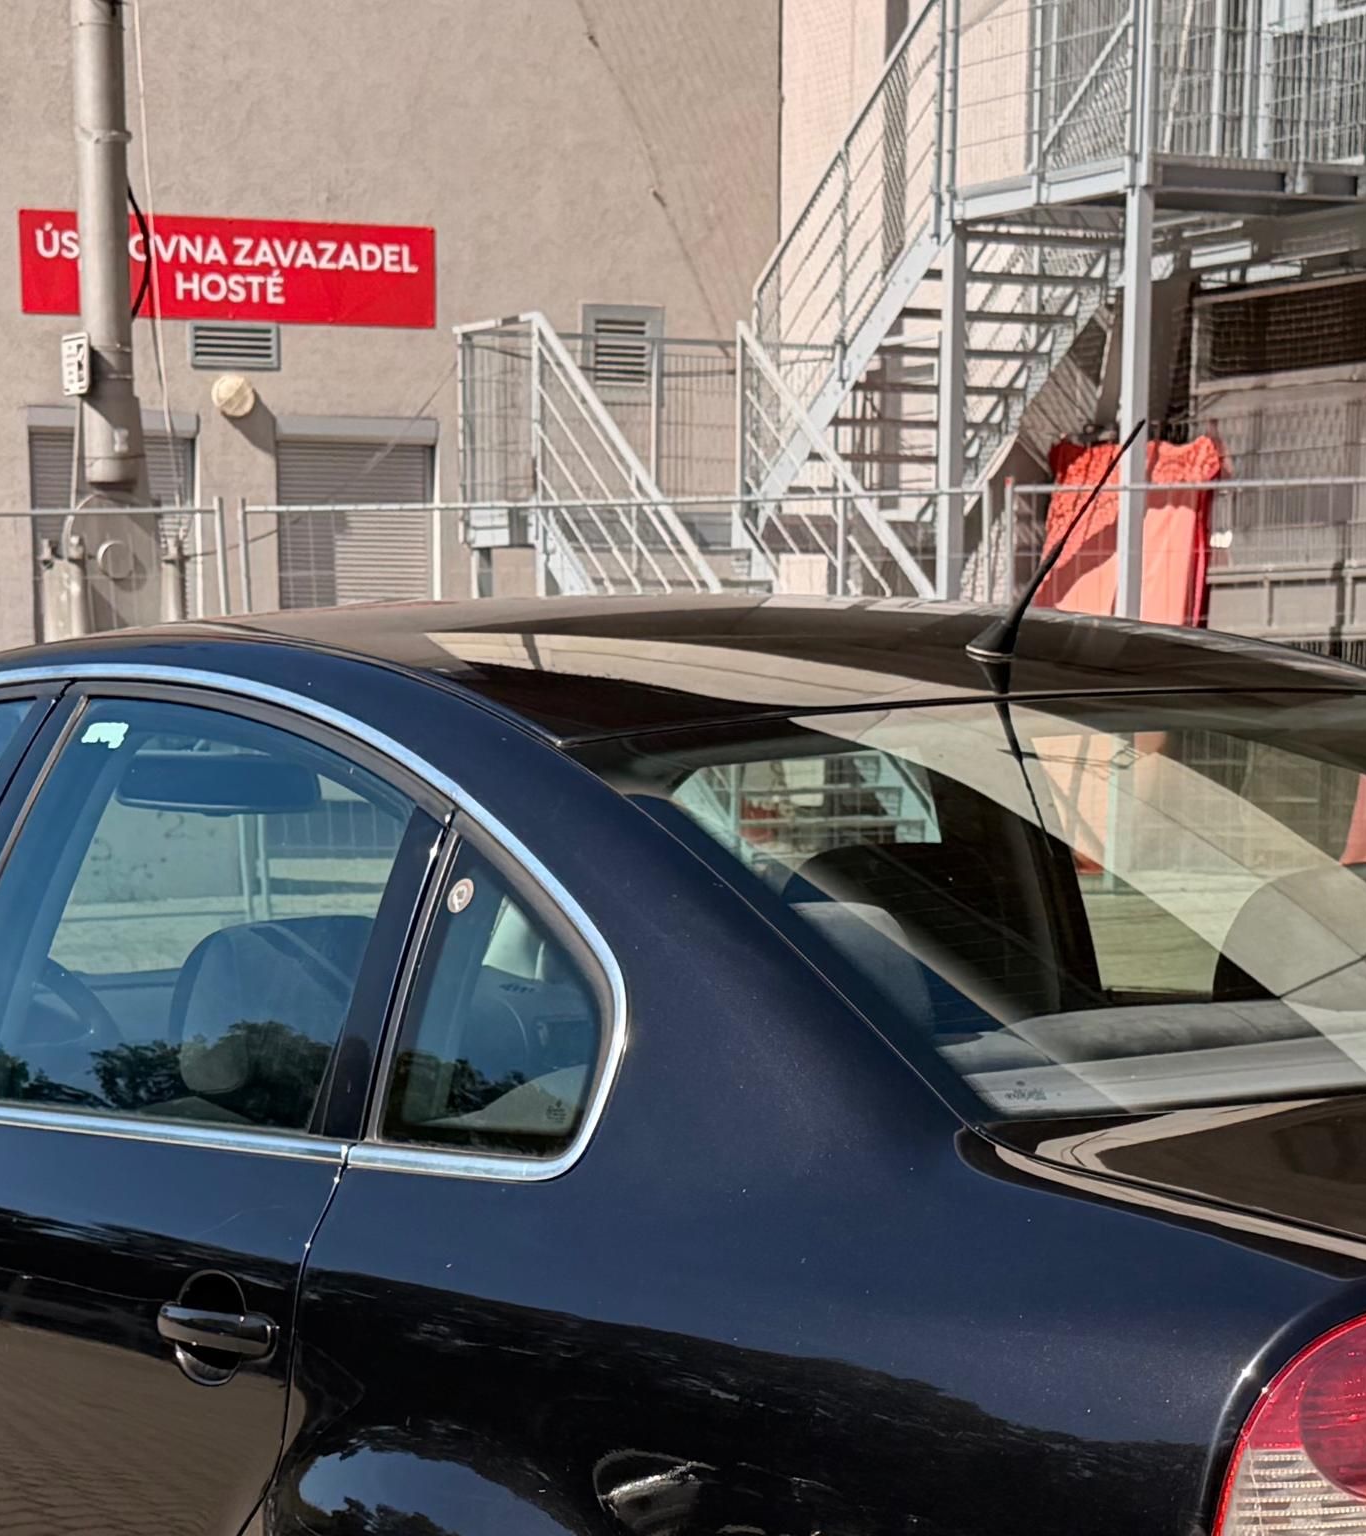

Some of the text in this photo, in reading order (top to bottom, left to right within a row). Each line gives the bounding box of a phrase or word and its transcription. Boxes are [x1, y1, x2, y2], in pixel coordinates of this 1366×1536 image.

[35, 222, 419, 273] ÚSOVNA ZAVAZADEL
[175, 269, 286, 304] HOSTÉ
